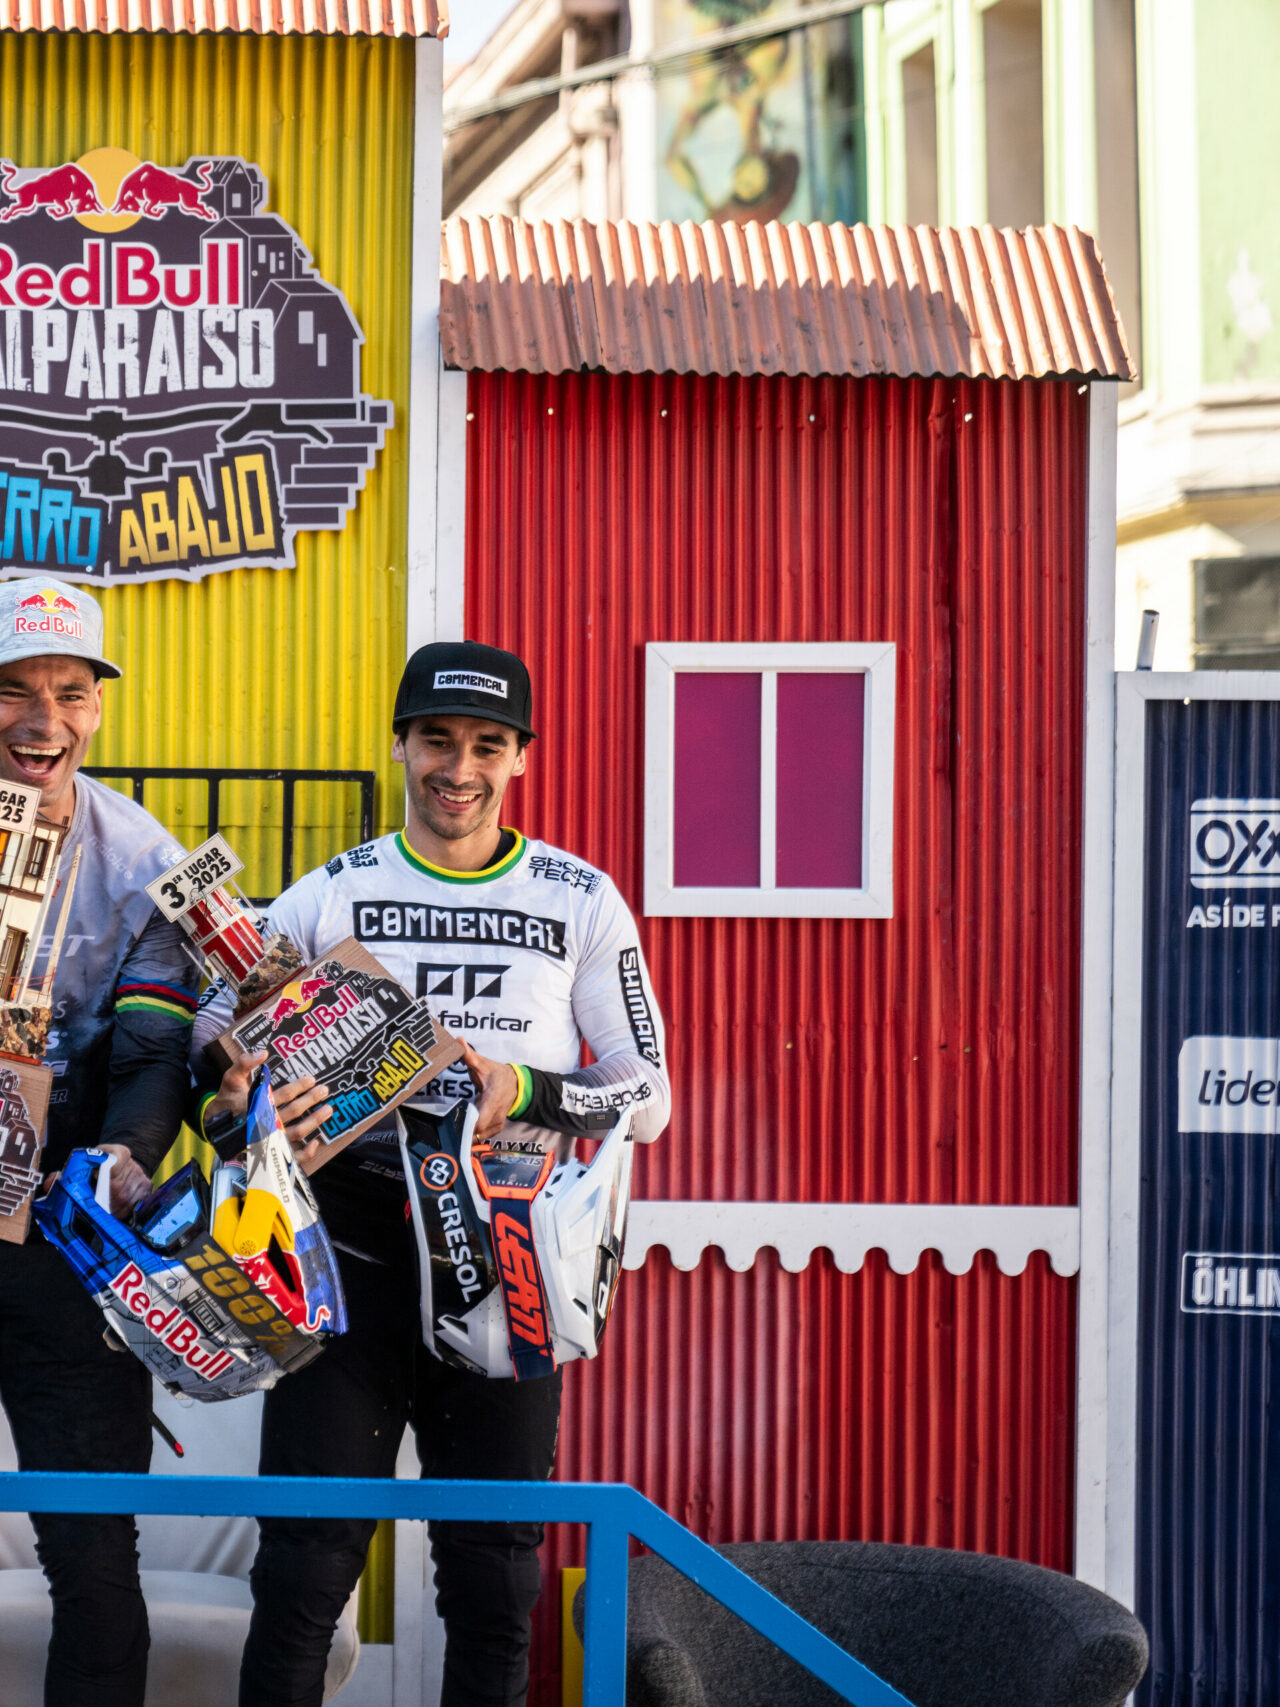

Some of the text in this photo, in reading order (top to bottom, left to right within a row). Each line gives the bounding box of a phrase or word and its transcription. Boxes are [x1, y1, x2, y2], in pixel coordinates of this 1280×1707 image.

[116, 241, 239, 306] Bull
[119, 453, 275, 567] ABAJO
[15, 615, 82, 638] Red Bull
[438, 675, 504, 693] COMMENCAL
[183, 847, 222, 879] LUGAR
[192, 856, 231, 892] 2025
[358, 906, 561, 954] COMMENCAL
[273, 985, 360, 1060] Red Bull
[275, 996, 388, 1084] VALPARAISO
[437, 1010, 533, 1033] fabricar
[372, 1038, 425, 1103] ABAJO
[1198, 1069, 1280, 1107] Lide
[438, 1192, 482, 1303] CRESOL
[111, 1263, 235, 1379] Red Bull
